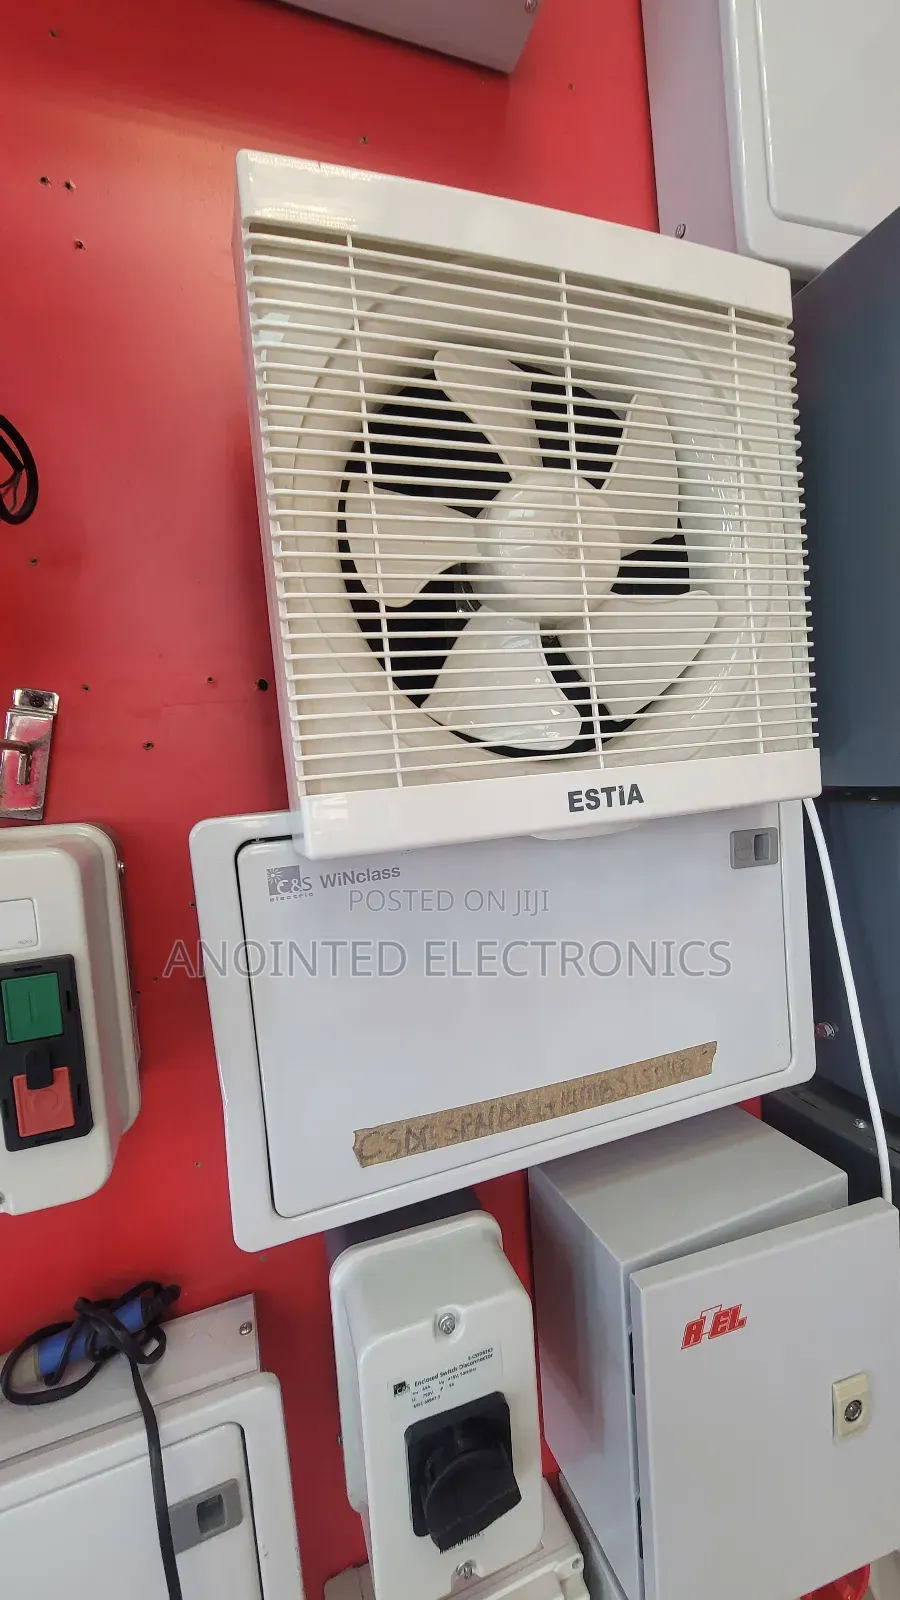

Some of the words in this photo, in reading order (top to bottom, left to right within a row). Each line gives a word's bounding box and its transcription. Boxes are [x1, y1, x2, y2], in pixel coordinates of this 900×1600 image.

[276, 876, 313, 895] C&S
[319, 866, 401, 889] WiNclass
[269, 891, 314, 902] electric
[414, 1373, 439, 1388] Enclosed
[439, 1366, 458, 1378] Switch
[458, 1353, 494, 1371] Disconnector
